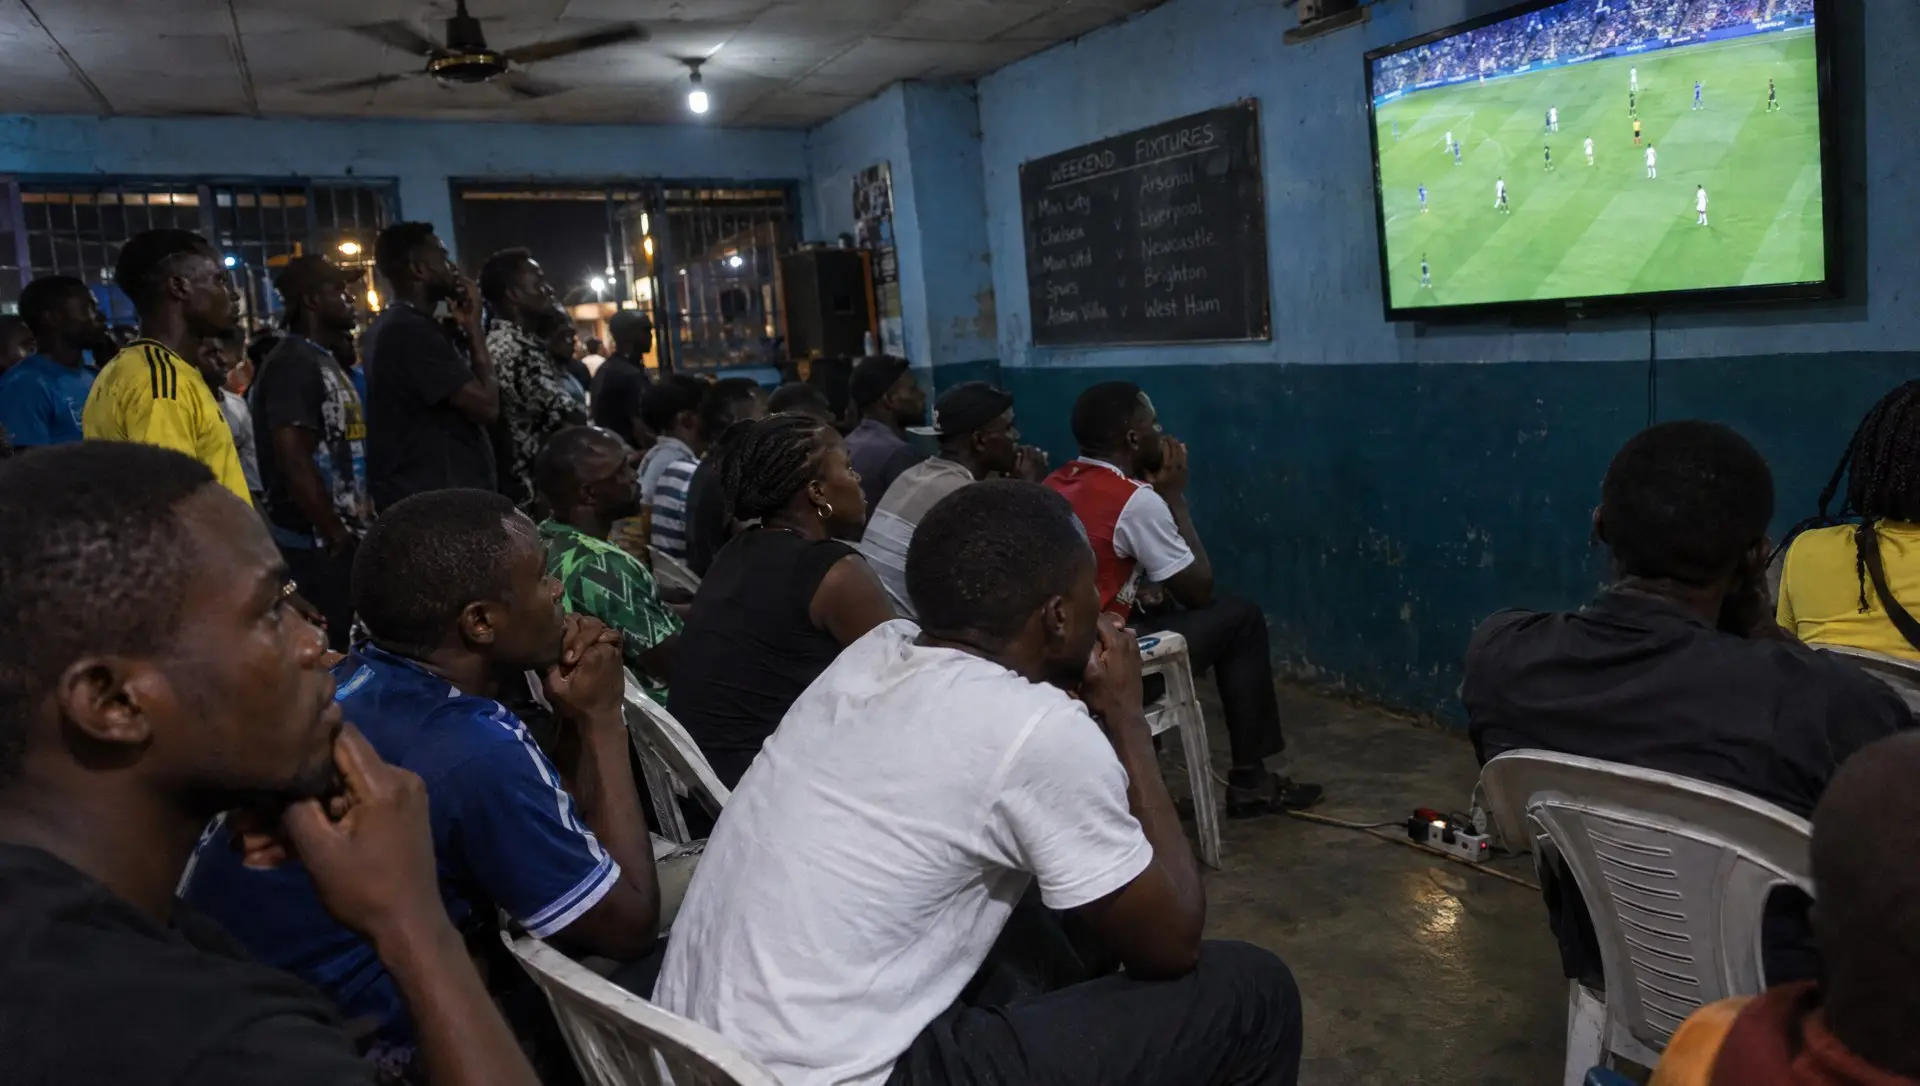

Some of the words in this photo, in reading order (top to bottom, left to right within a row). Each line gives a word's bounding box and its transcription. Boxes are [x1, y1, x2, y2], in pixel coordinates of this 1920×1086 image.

[1051, 151, 1115, 183] WEEKEND
[1135, 125, 1214, 161] FIXTURES
[1038, 199, 1063, 218] Man
[1066, 194, 1091, 217] City
[1140, 170, 1193, 195] Arsenal
[1040, 225, 1085, 246] Chelsea
[1139, 200, 1202, 227] Liverpool
[1042, 254, 1067, 274] Man
[1141, 231, 1214, 260] Newcastle
[1046, 281, 1079, 302] Spurs
[1144, 265, 1207, 292] Brighton
[1046, 306, 1078, 325] Aston
[1145, 297, 1178, 319] West
[1185, 293, 1220, 316] Ham
